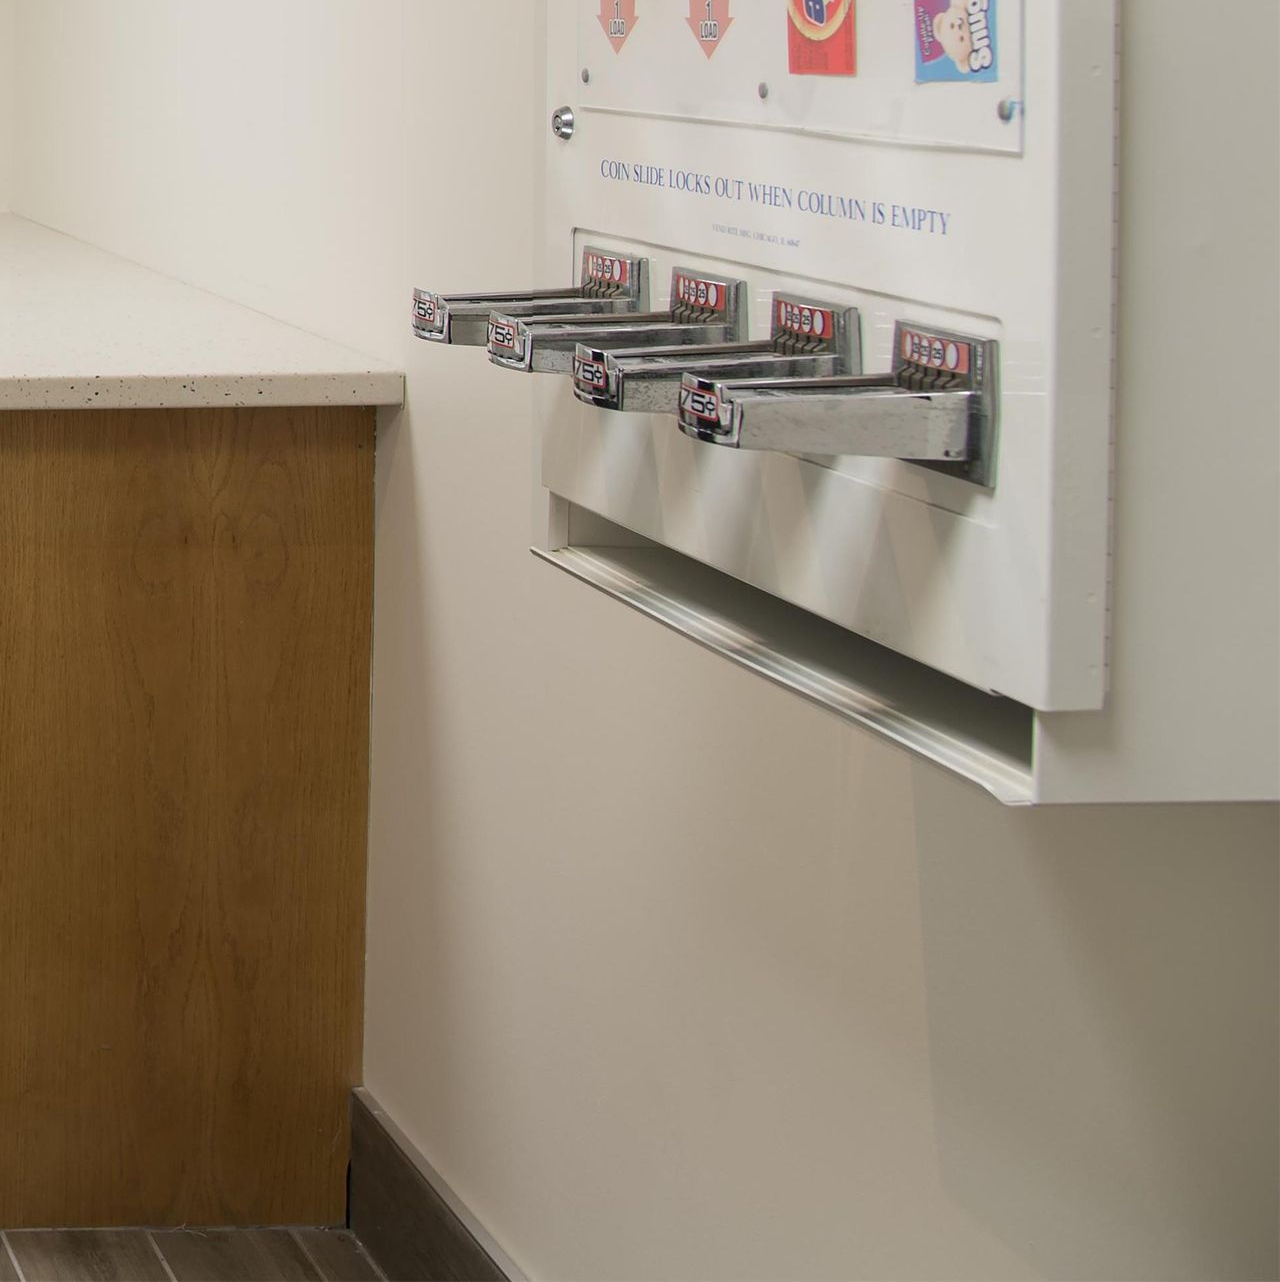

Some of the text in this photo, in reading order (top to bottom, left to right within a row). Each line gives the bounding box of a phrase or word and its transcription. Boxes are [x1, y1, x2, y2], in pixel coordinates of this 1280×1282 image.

[614, 0, 620, 20] 1
[705, 0, 712, 21] 1
[609, 21, 625, 36] LOAD
[700, 22, 719, 39] LOAD
[600, 159, 952, 235] COIN SLIDE LOCKS OUT WHEN COLUMN IS EMPTY
[604, 265, 611, 274] 25
[698, 288, 706, 299] 25
[413, 298, 433, 319] 75¢
[802, 314, 810, 325] 25
[489, 322, 513, 345] 75¢
[933, 347, 942, 359] 25
[575, 358, 603, 384] 75¢
[682, 388, 715, 416] 75¢
